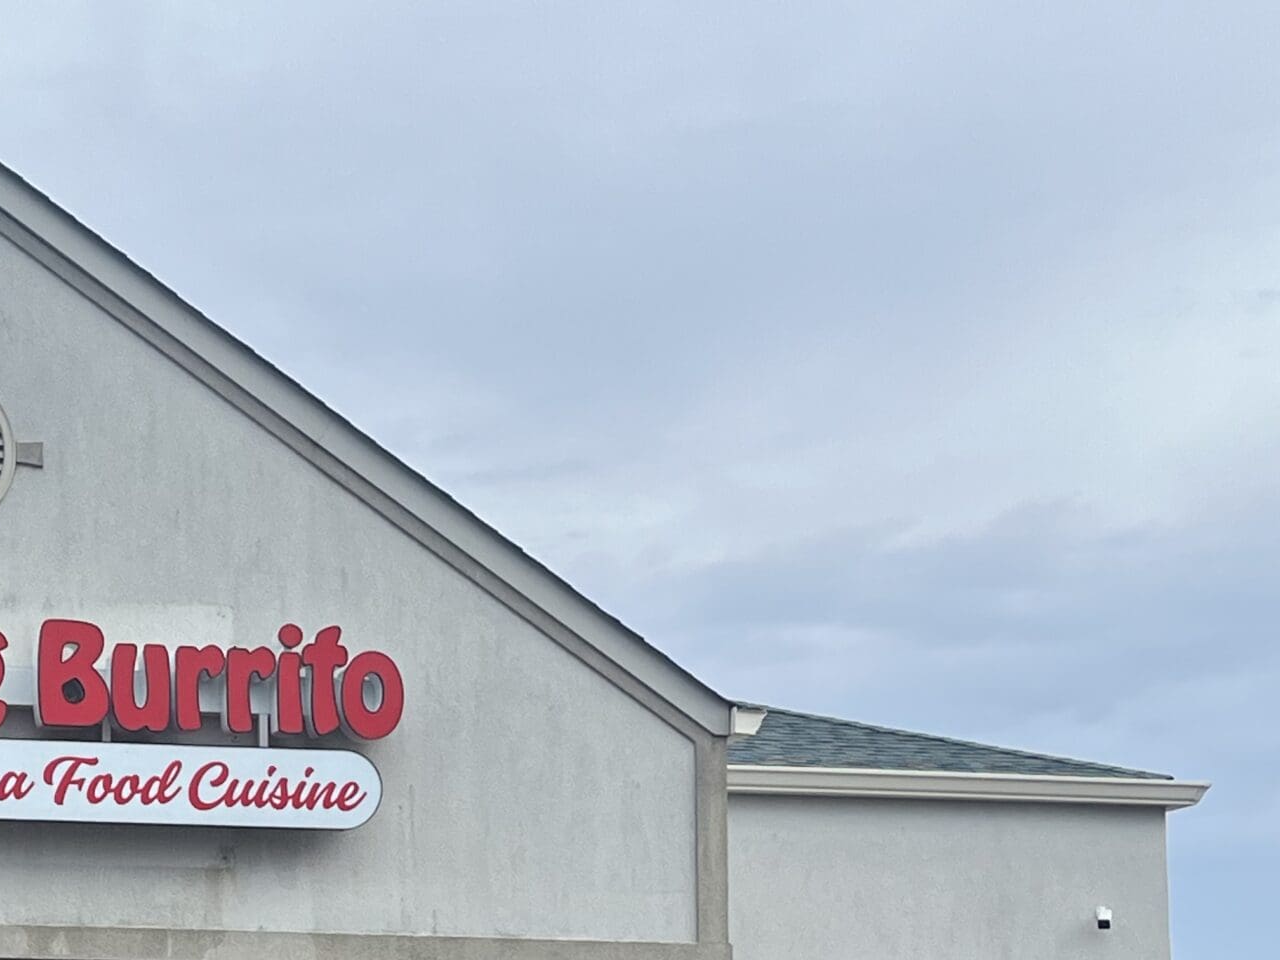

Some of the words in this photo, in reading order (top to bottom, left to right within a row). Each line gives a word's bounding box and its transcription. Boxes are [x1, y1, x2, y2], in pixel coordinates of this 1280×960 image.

[37, 619, 404, 740] Burrito
[43, 756, 183, 807] Food
[188, 761, 367, 812] Cuisine
